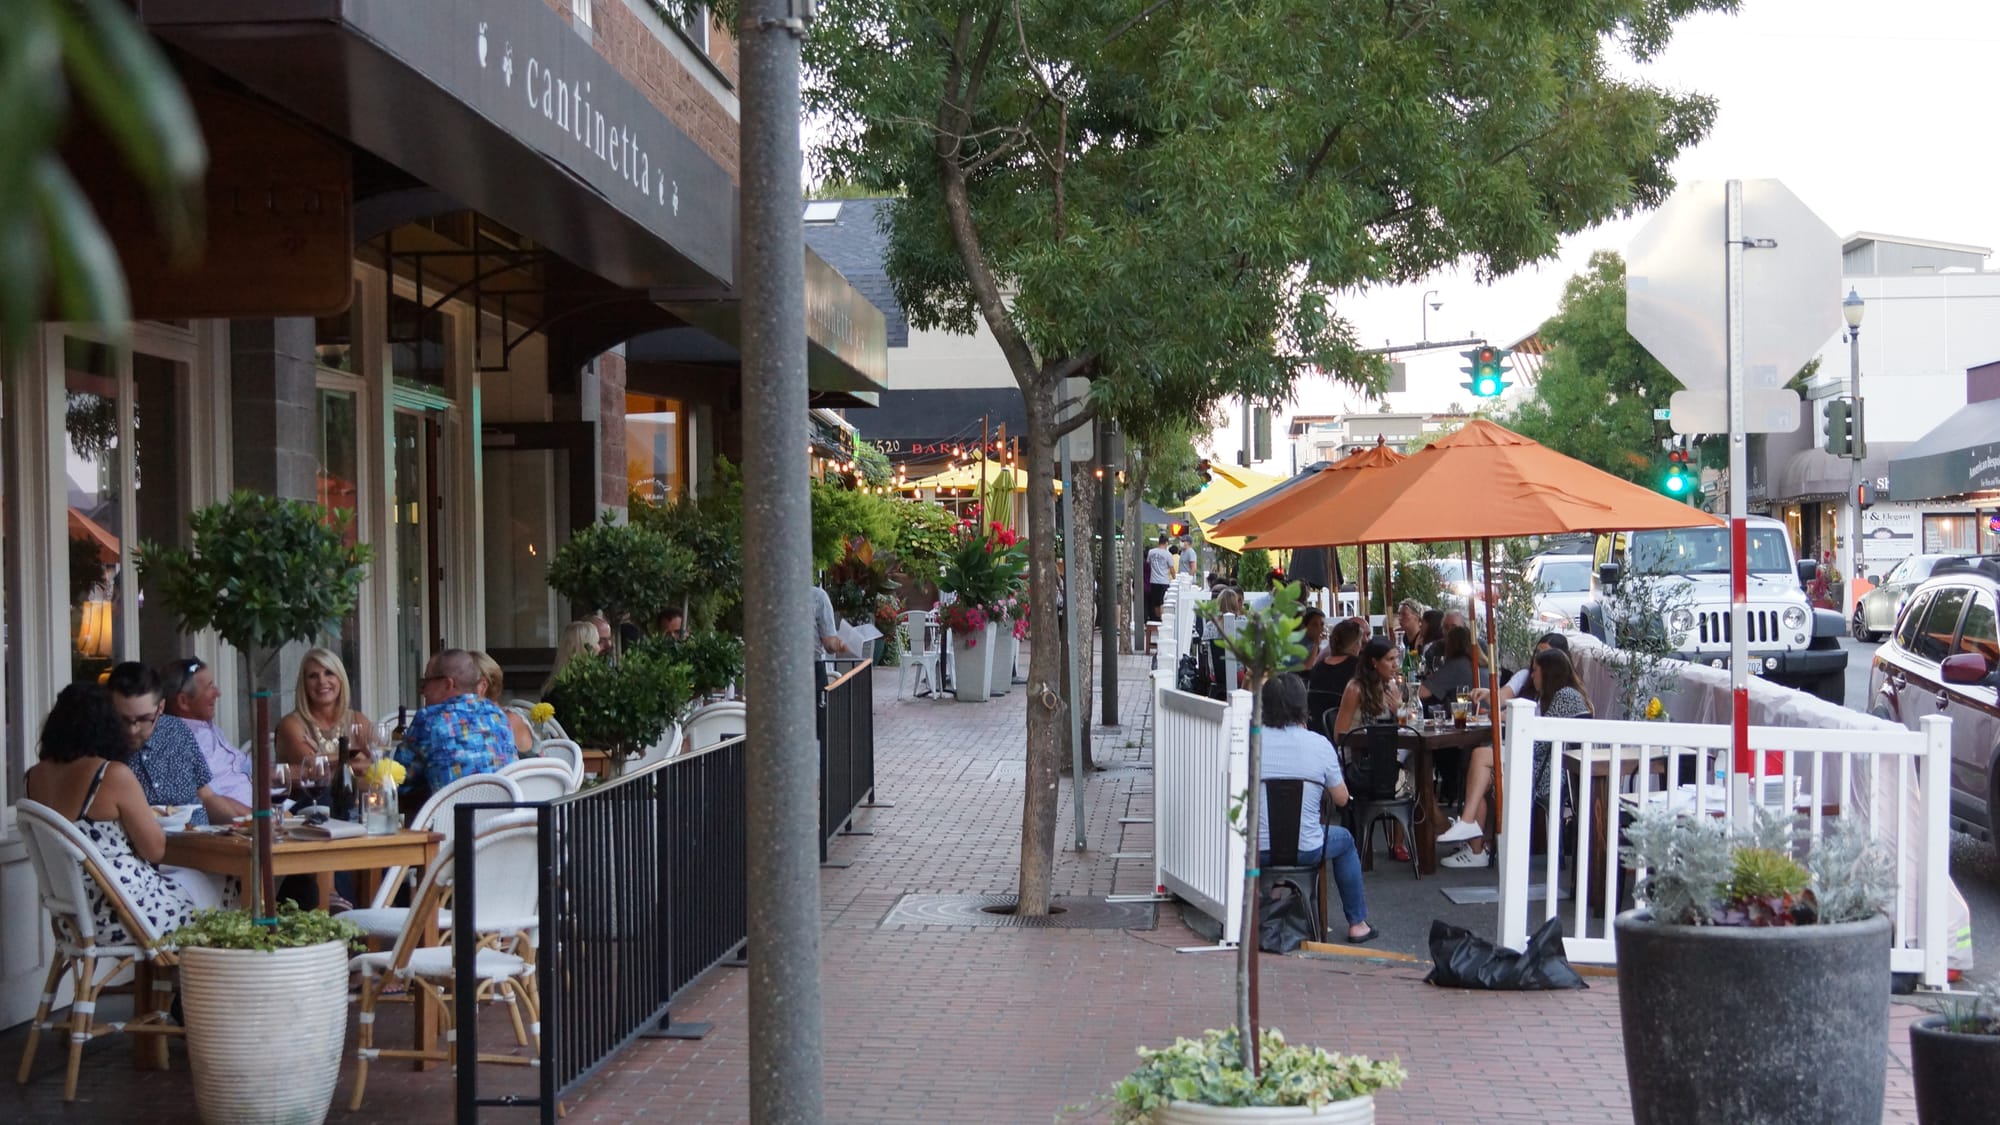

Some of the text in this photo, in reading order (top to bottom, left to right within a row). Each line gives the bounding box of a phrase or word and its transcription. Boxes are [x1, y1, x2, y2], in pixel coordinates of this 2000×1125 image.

[876, 440, 900, 455] 520
[912, 443, 950, 454] BAR
[1871, 512, 1880, 520] &
